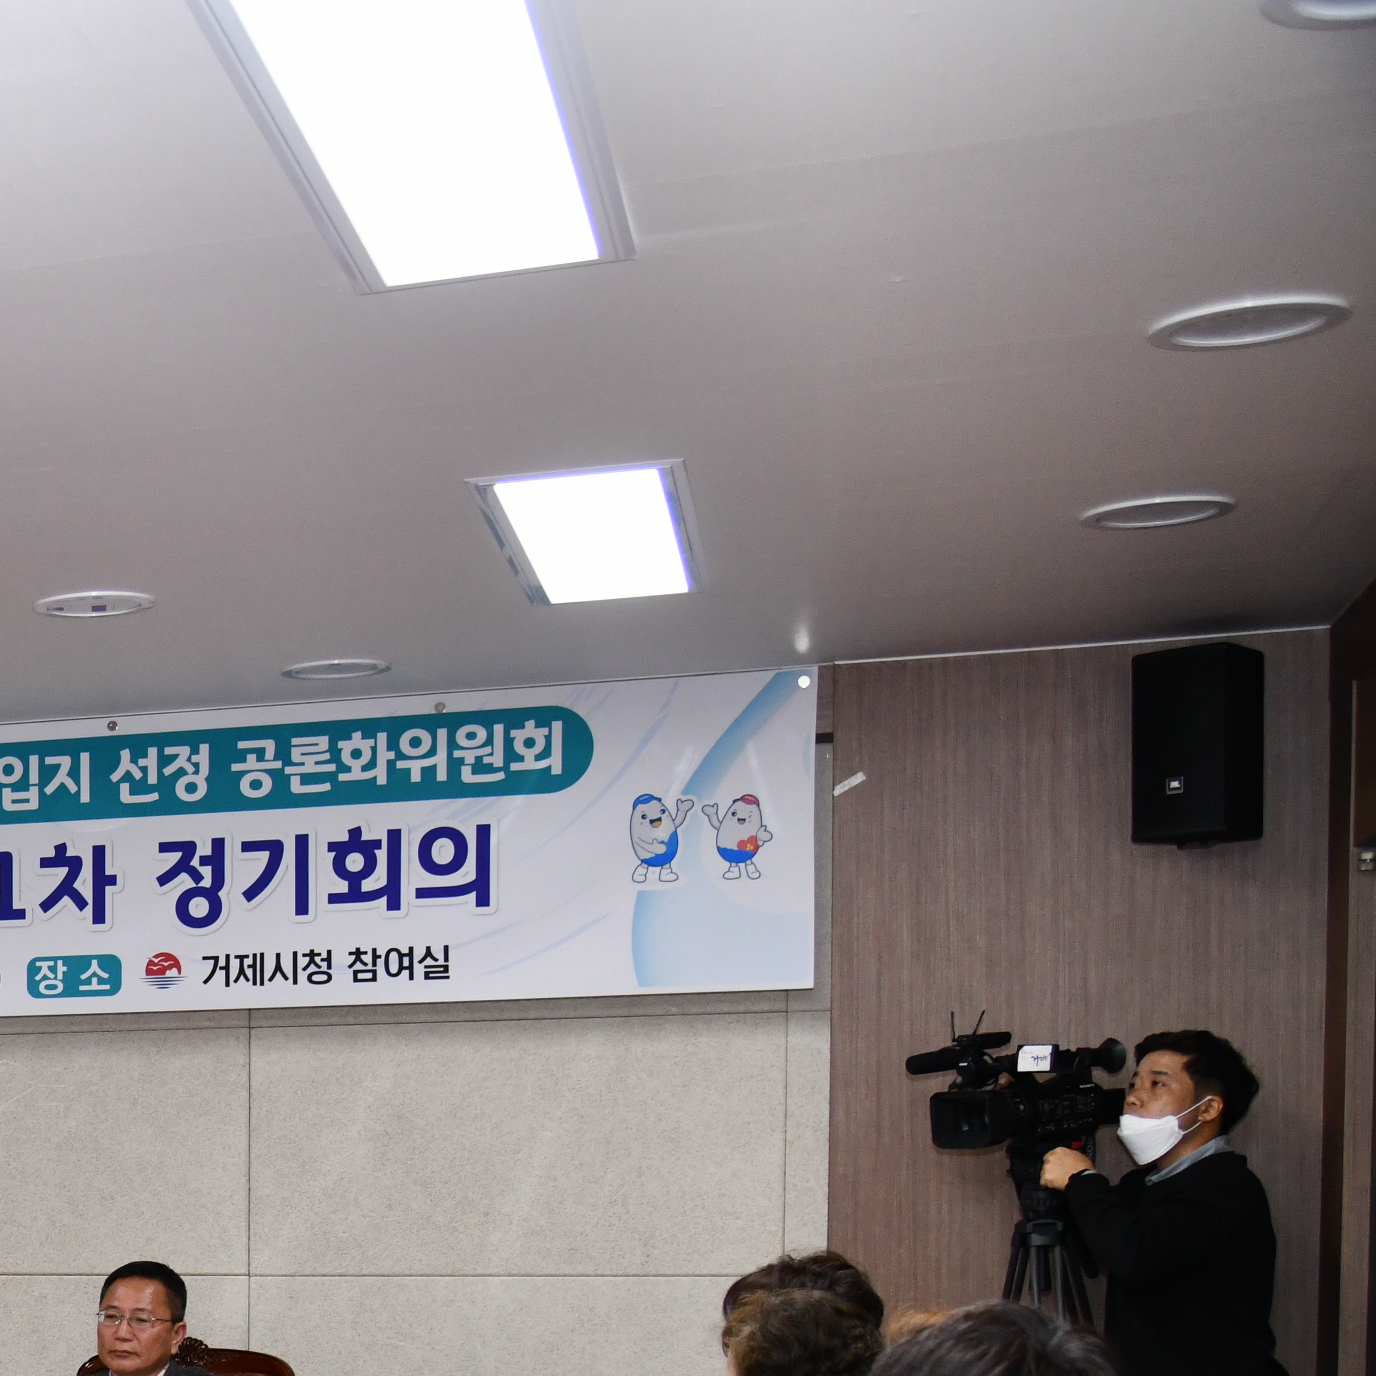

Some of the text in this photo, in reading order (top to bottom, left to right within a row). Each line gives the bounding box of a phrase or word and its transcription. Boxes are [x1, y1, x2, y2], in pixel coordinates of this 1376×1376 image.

[110, 743, 210, 804] 선정
[230, 719, 564, 798] 공론화위원회
[156, 824, 492, 929] 정기회의
[202, 945, 451, 988] 거제시청 참여실
